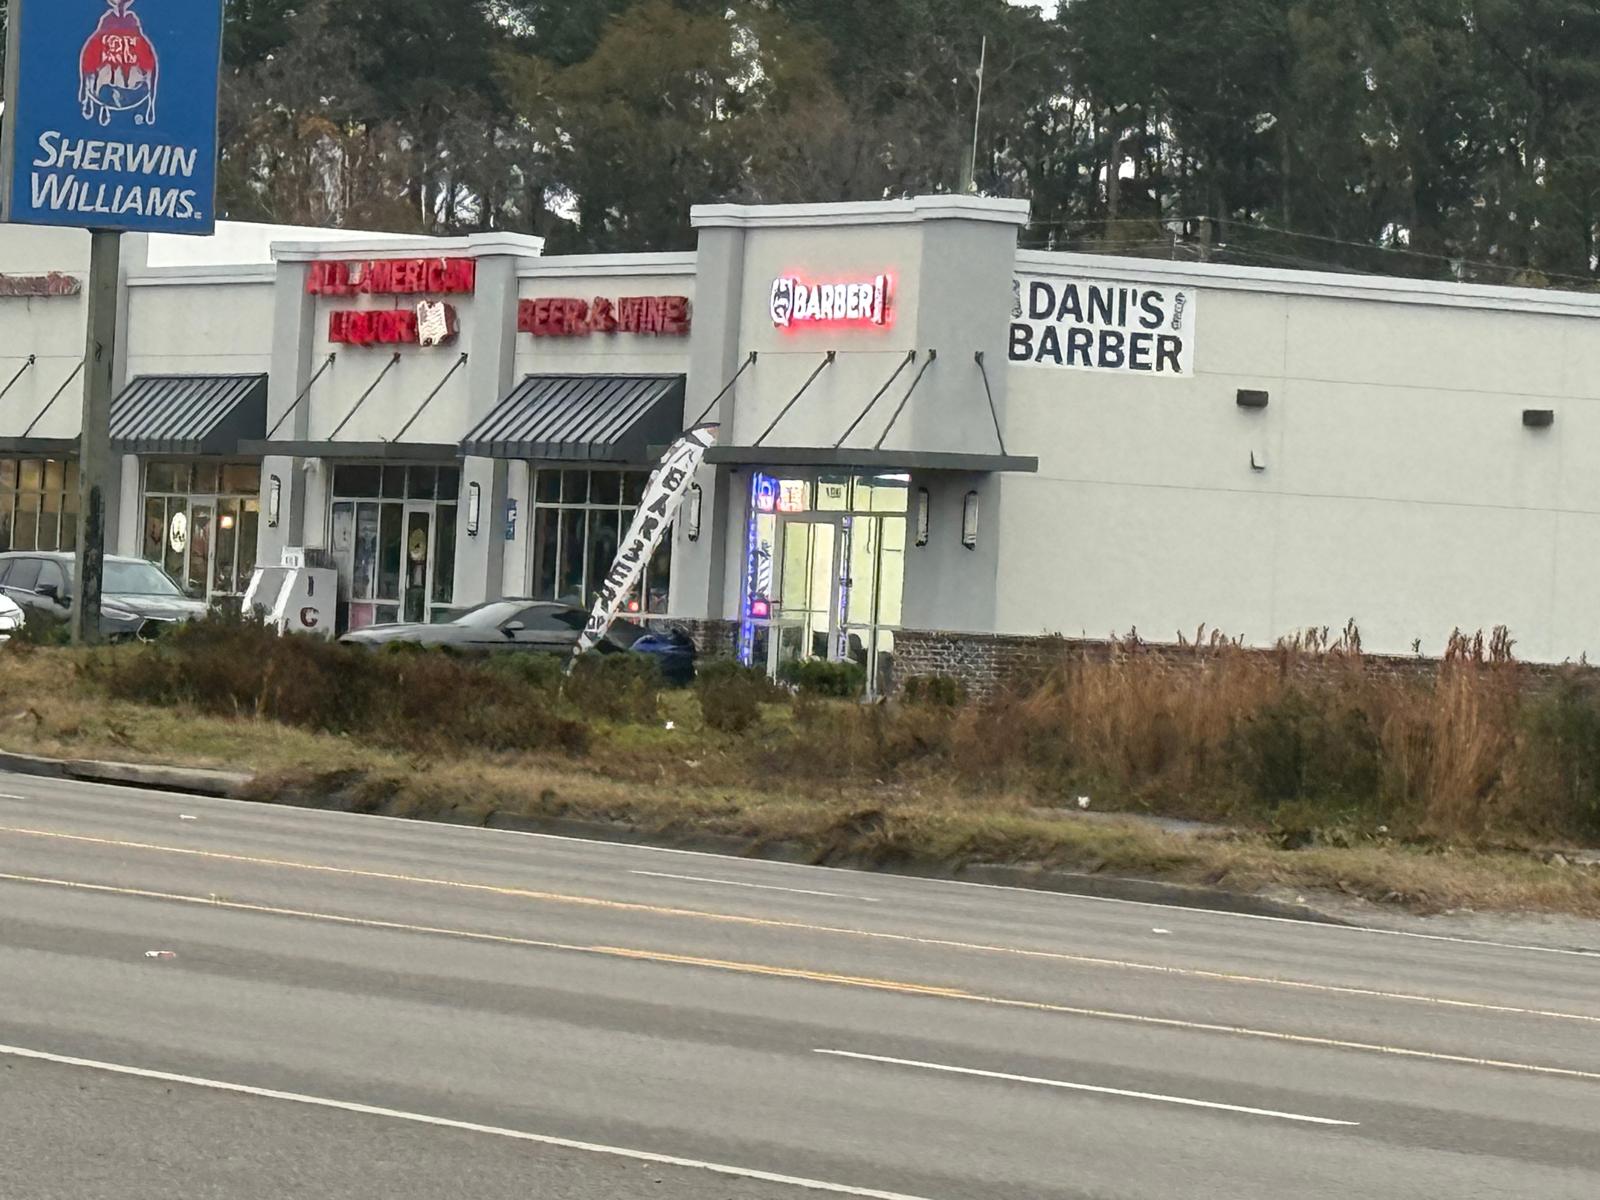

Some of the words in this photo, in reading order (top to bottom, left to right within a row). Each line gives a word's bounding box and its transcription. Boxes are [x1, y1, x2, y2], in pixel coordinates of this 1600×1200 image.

[33, 130, 198, 177] SHERWIN
[793, 283, 874, 321] BARBER
[1028, 280, 1165, 330] DANI'S
[1008, 322, 1184, 374] BARBER
